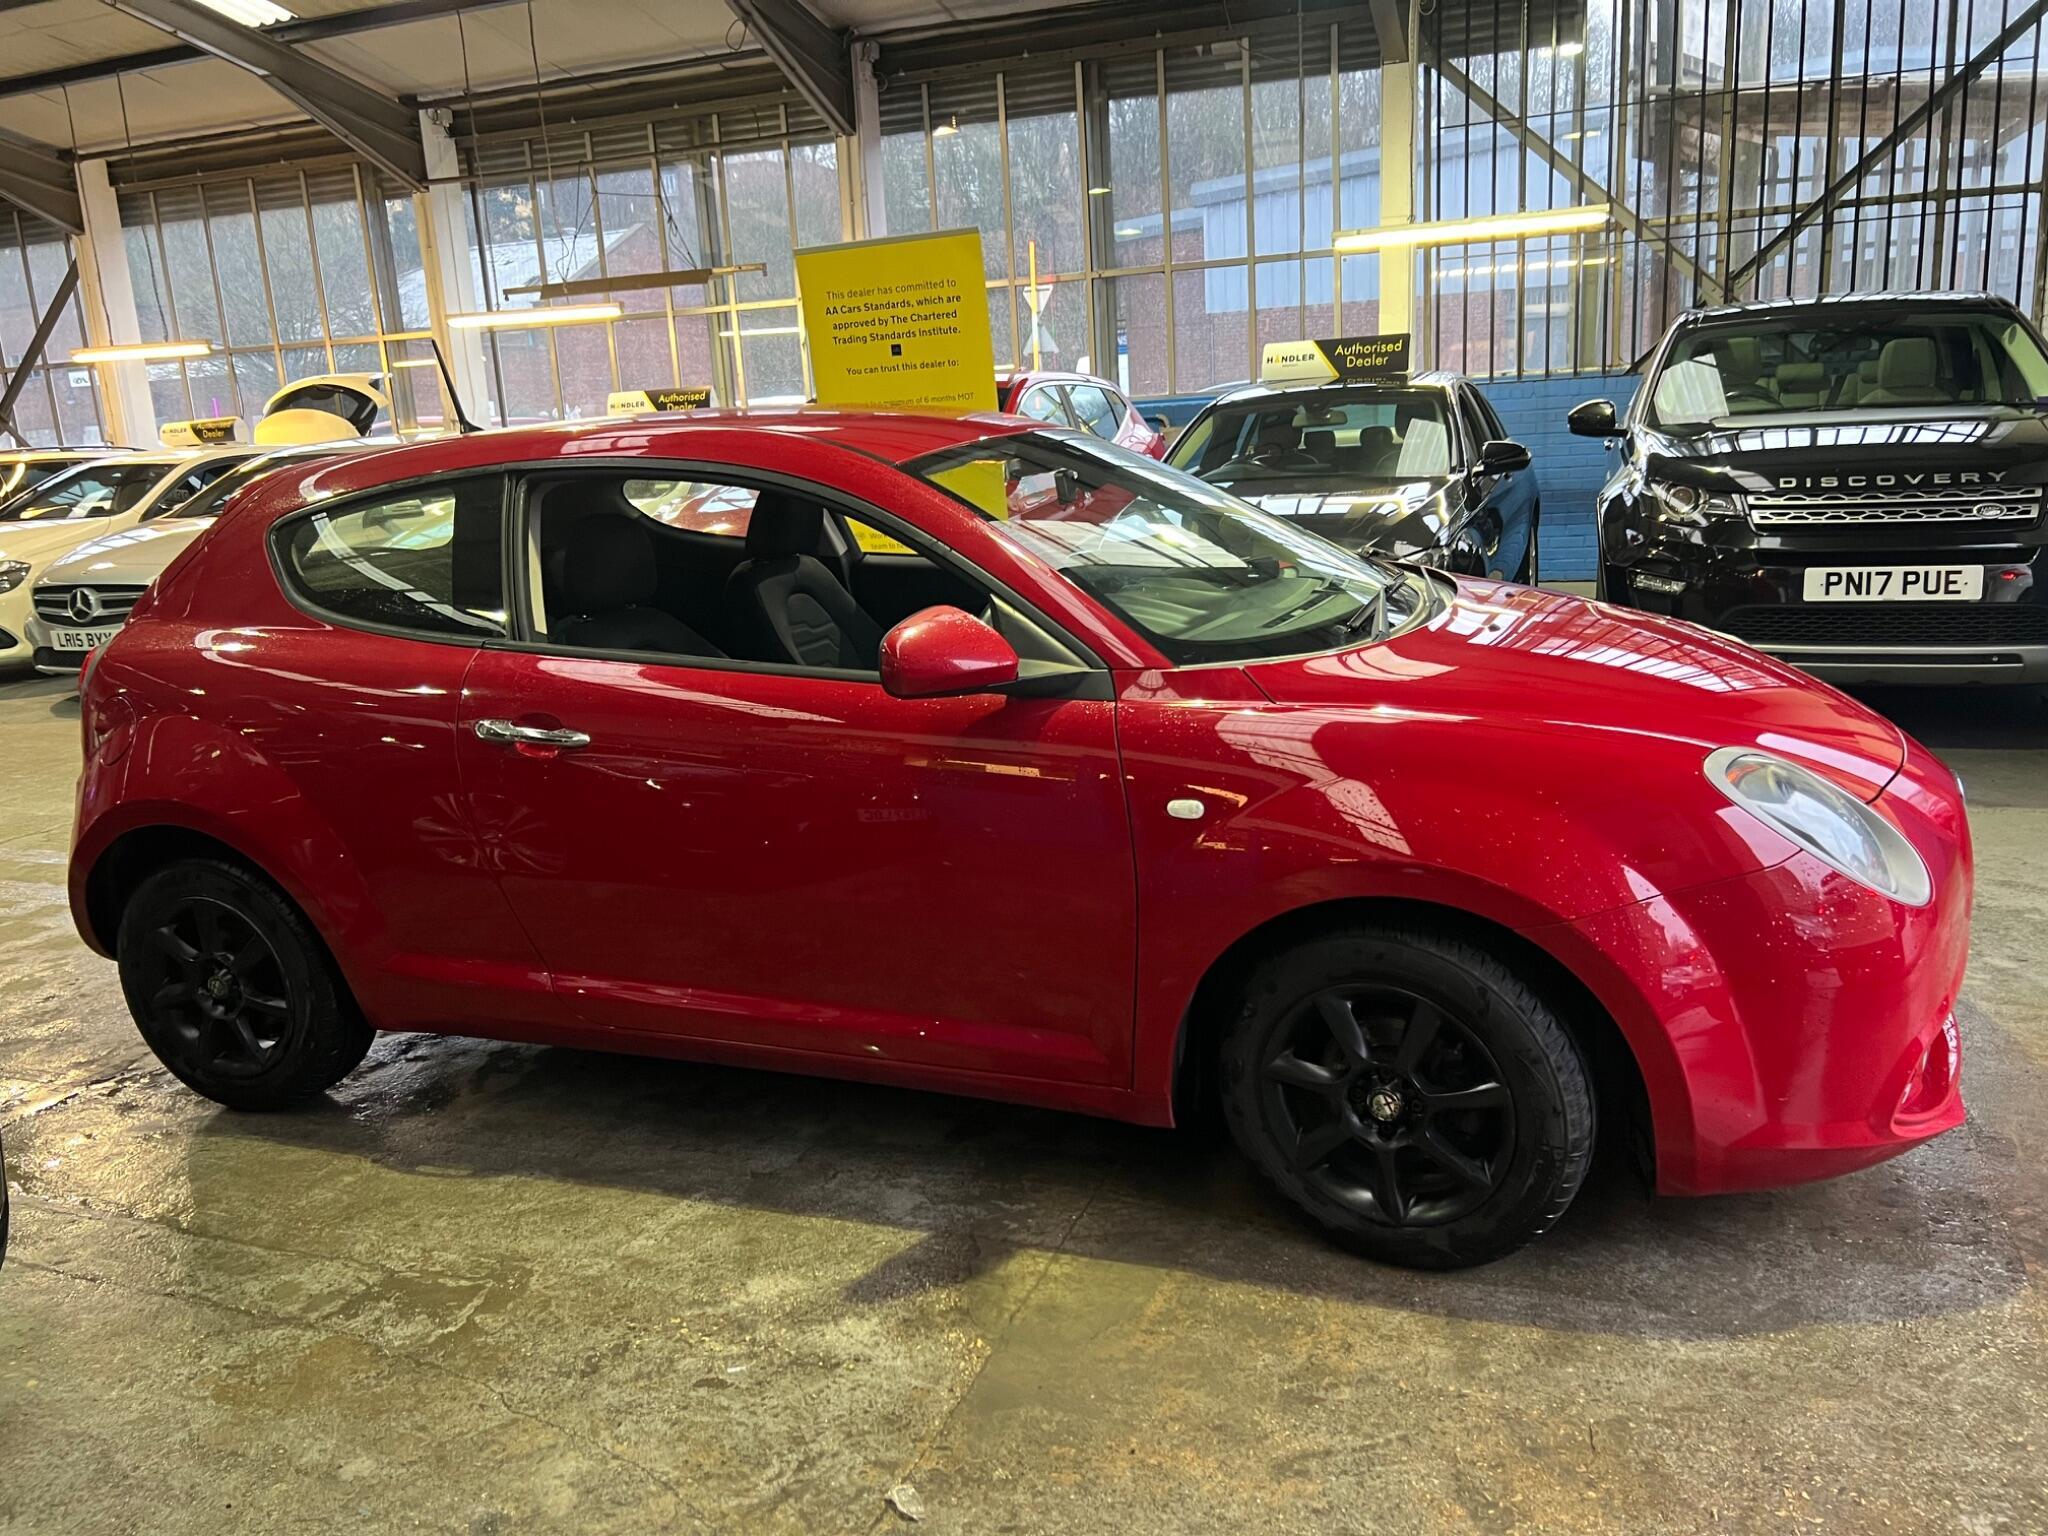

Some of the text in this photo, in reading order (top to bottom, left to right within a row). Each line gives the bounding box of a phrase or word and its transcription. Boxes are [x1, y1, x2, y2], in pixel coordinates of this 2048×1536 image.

[826, 278, 957, 301] This dealer has committed to
[825, 294, 961, 317] AA Cars Standards, which are
[832, 309, 957, 332] approved by The Chartered
[832, 324, 961, 346] Trading Standards Institute.
[1335, 339, 1403, 356] Authorised
[846, 358, 960, 376] You can trust this dealer to:
[1266, 353, 1316, 365] HANDLER
[1346, 355, 1390, 368] Dealer
[658, 390, 707, 404] Authorised
[957, 391, 975, 401] MOT
[667, 402, 697, 412] Dealer
[202, 429, 225, 439] Dealer
[1779, 471, 2008, 489] DISCOVERY
[1824, 570, 1963, 596] PN17 PUE
[56, 632, 84, 648] LR15
